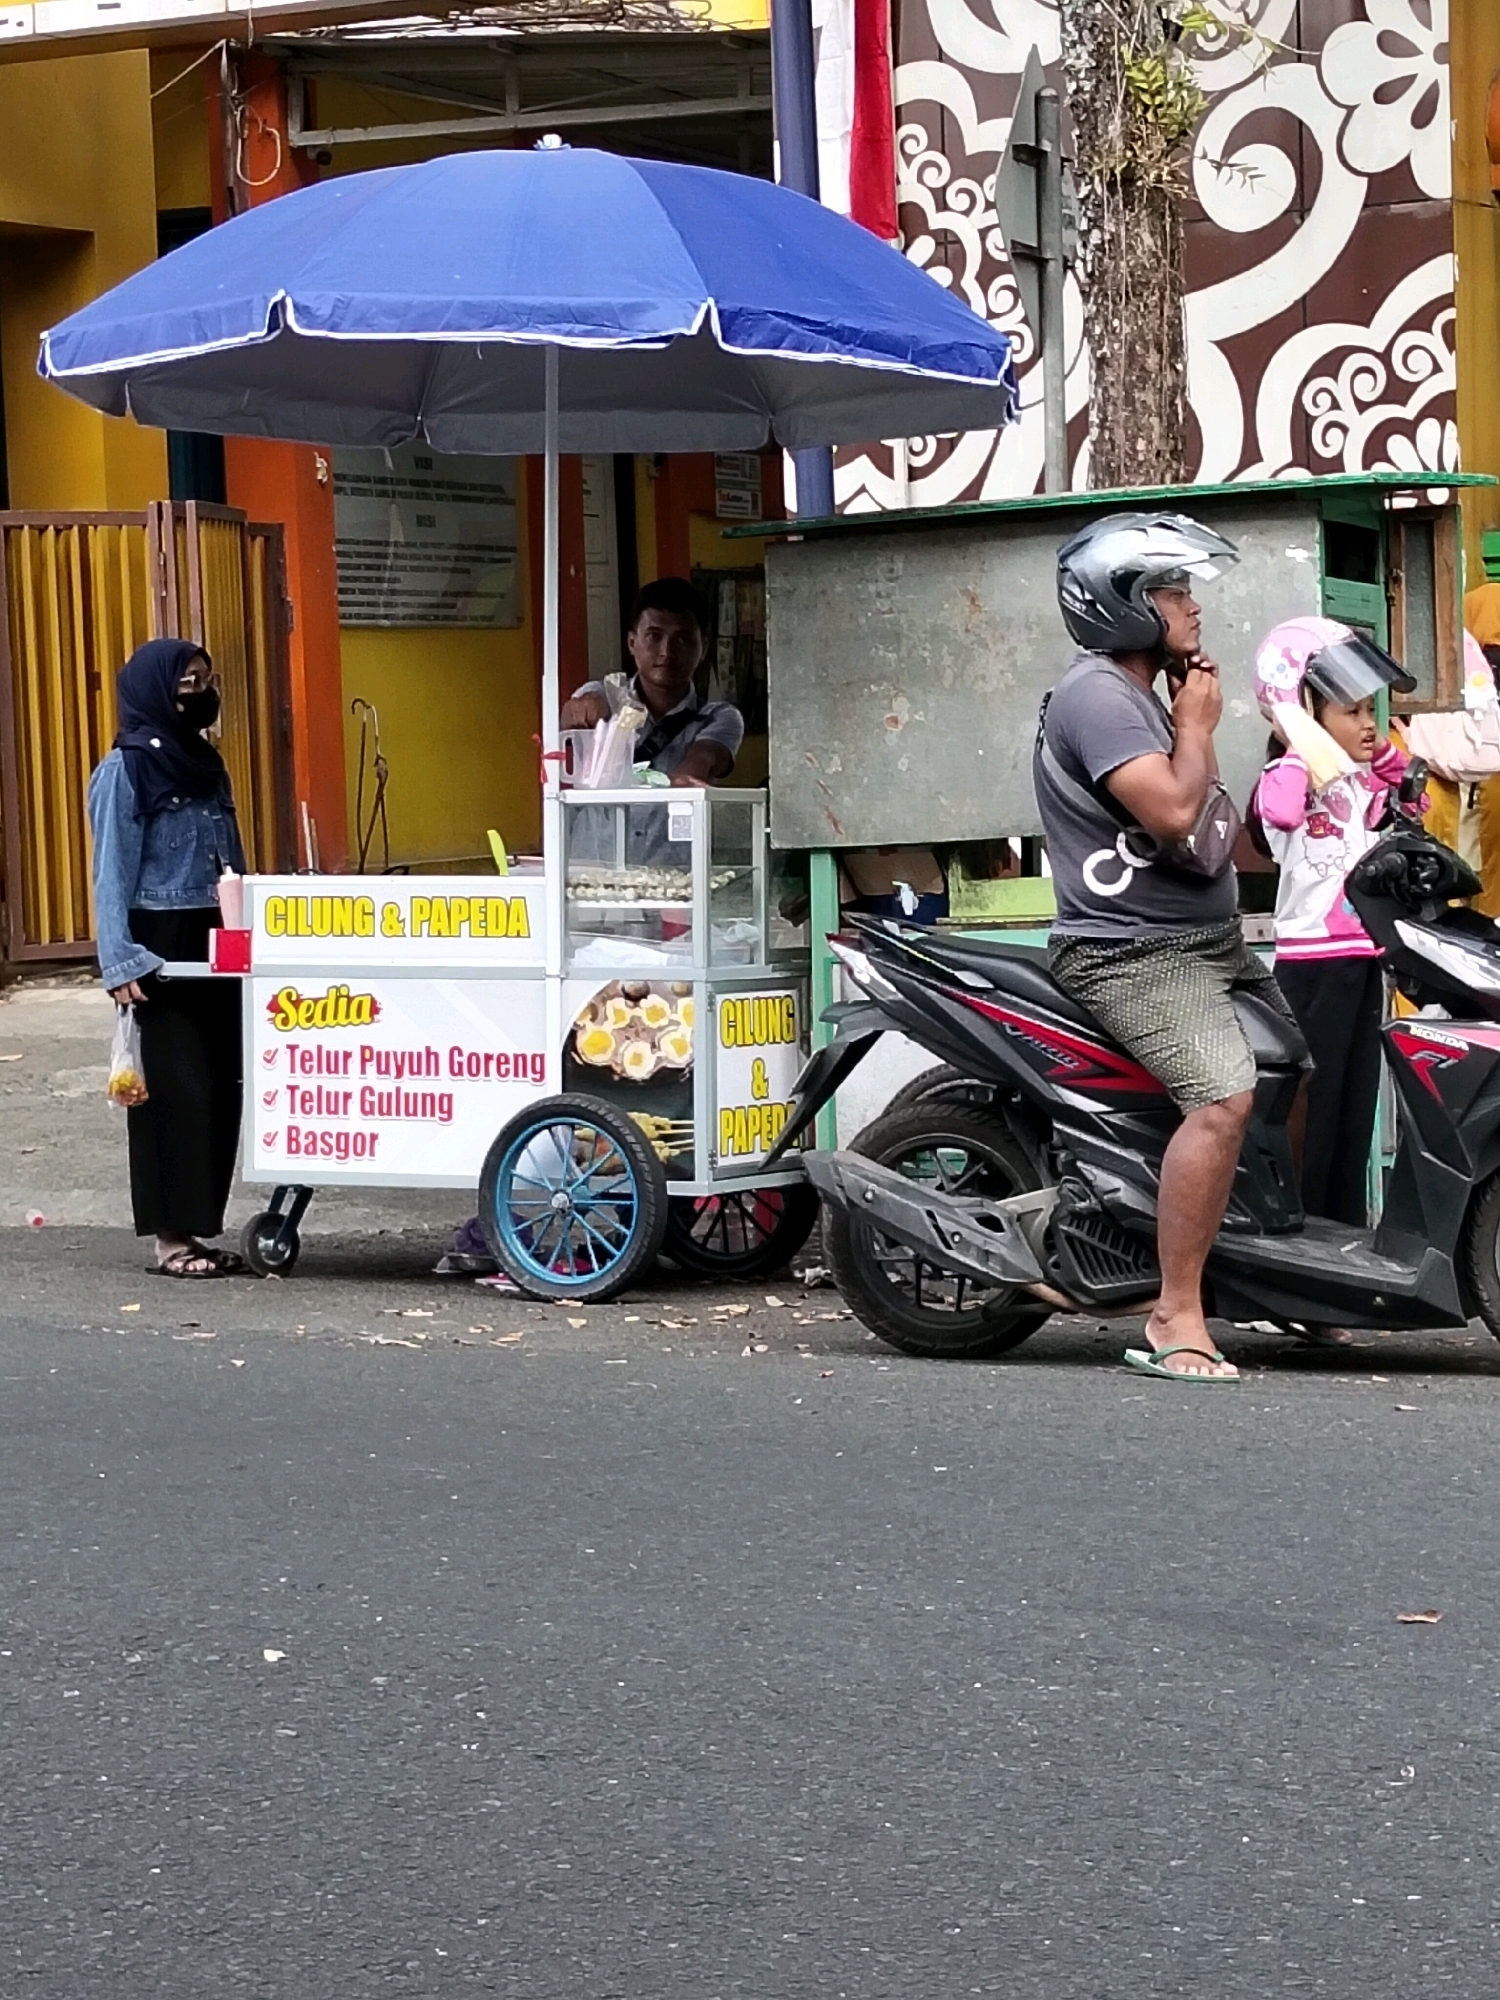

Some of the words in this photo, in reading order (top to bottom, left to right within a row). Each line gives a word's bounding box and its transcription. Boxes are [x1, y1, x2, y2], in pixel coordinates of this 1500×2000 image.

[413, 455, 433, 471] VISI
[265, 895, 375, 938] CILUNG
[381, 902, 406, 938] &
[410, 895, 531, 938] PAPEDA
[274, 984, 373, 1032] Sedia
[720, 994, 795, 1049] CILUNG
[1409, 1023, 1470, 1052] HONDA
[286, 1044, 353, 1076] Telur
[360, 1045, 440, 1080] Puyuh
[449, 1045, 546, 1083] Goreng
[751, 1057, 770, 1101] &
[286, 1084, 353, 1116] Telur
[360, 1085, 454, 1123] Gulung
[286, 1125, 379, 1161] Basgor
